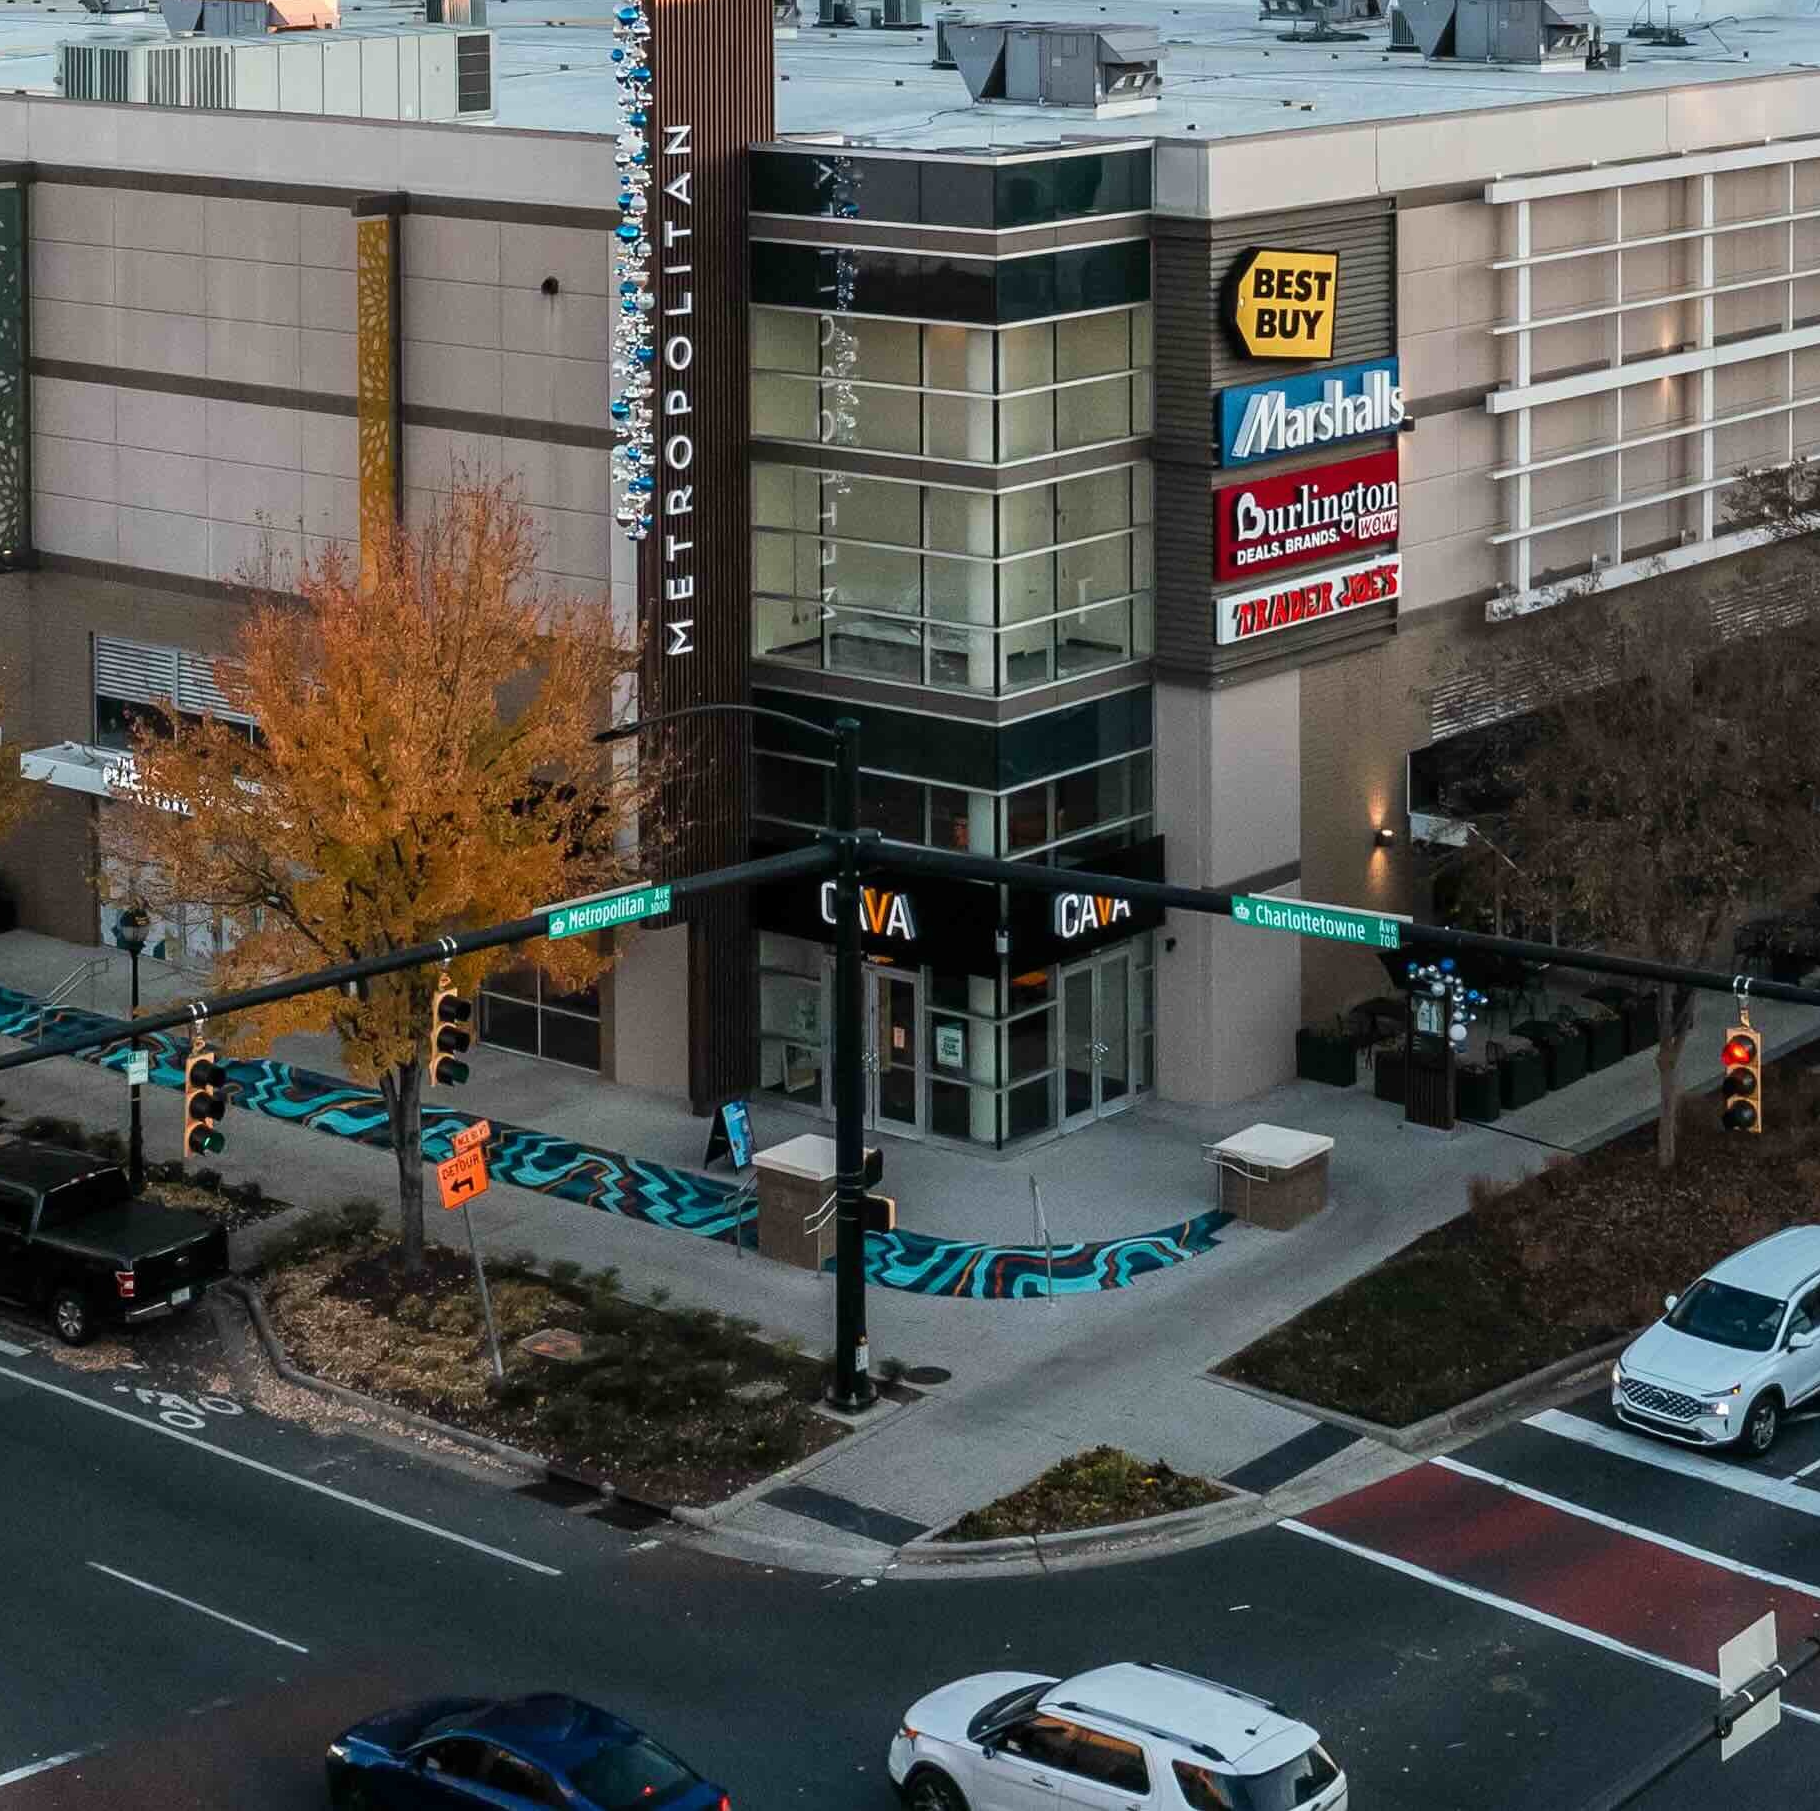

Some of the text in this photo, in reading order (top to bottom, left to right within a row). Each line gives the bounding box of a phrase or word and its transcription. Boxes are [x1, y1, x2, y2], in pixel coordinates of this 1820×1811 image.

[1253, 268, 1331, 302] BEST
[1255, 308, 1325, 340] BUY
[665, 124, 693, 656] METROPOLITAN
[1232, 370, 1405, 457] Marshalls
[1237, 481, 1398, 541] Burlington
[1237, 542, 1283, 566] DEALS.
[1285, 528, 1340, 554] BRANDS.
[1238, 564, 1399, 635] TRADER JOE'S
[650, 900, 670, 915] 1000
[654, 887, 670, 901] Ave
[821, 880, 913, 940] CVA
[568, 897, 645, 930] Metropolitan
[1059, 892, 1130, 938] CAVA
[1255, 904, 1366, 940] Charlottetowne
[1379, 919, 1398, 935] Ave
[1380, 934, 1399, 949] 700
[441, 1153, 479, 1181] DETOUR
